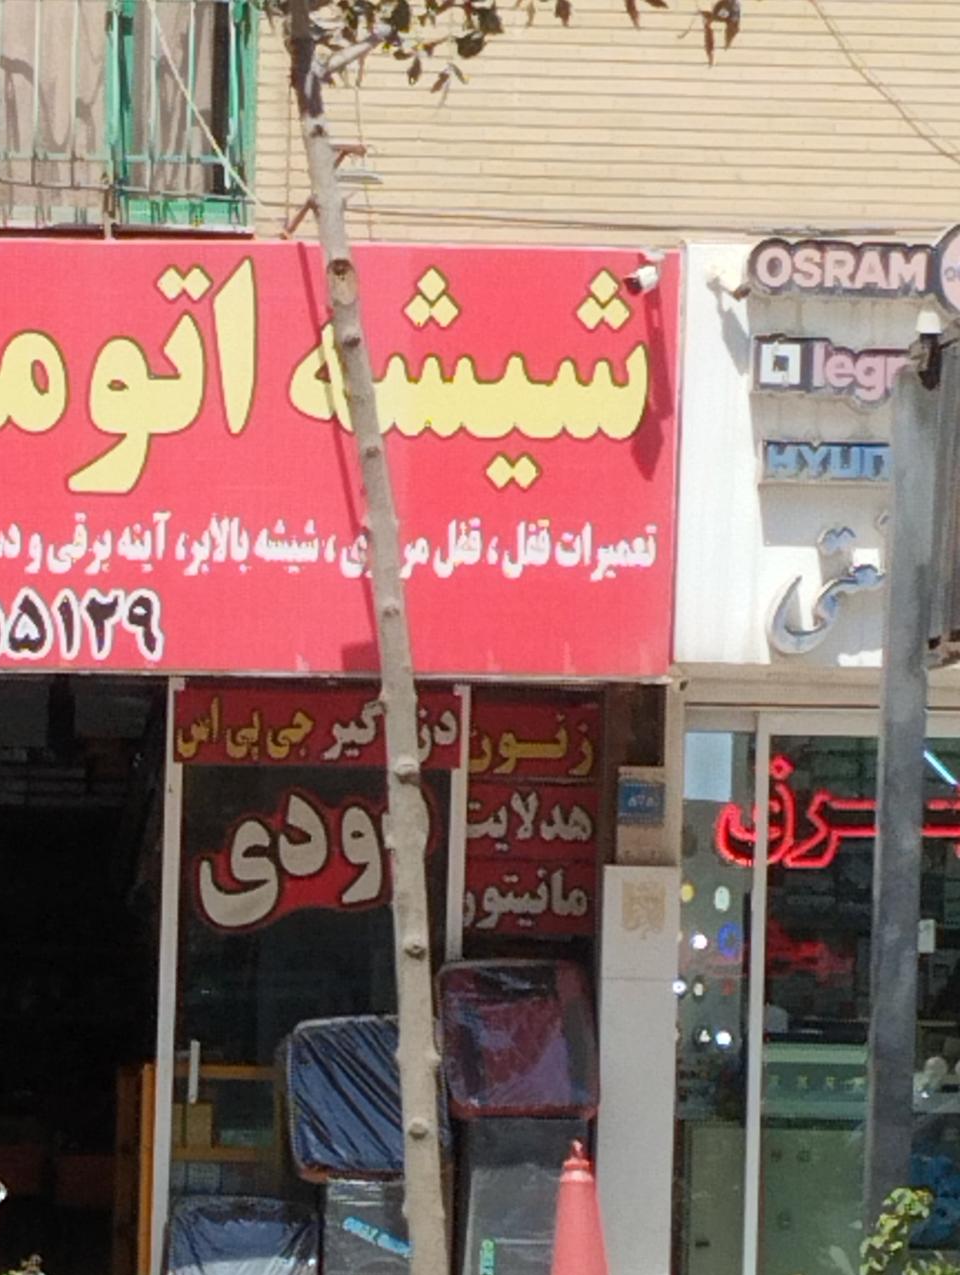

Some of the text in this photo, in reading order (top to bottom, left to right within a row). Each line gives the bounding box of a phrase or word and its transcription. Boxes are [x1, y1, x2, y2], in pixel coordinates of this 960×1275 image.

[755, 246, 928, 292] OSRAM
[289, 267, 648, 490] شیشه
[812, 342, 908, 401] legr
[24, 532, 43, 574] و
[47, 511, 114, 575] برقی
[117, 511, 172, 573] آینه
[253, 517, 320, 574] شیشه
[432, 517, 481, 578] قفل
[555, 521, 656, 582] تعمیرات
[177, 697, 220, 759] اس
[226, 710, 261, 761] پی
[266, 711, 315, 759] جی
[466, 791, 594, 852] هدلایت
[198, 793, 388, 930] ودی
